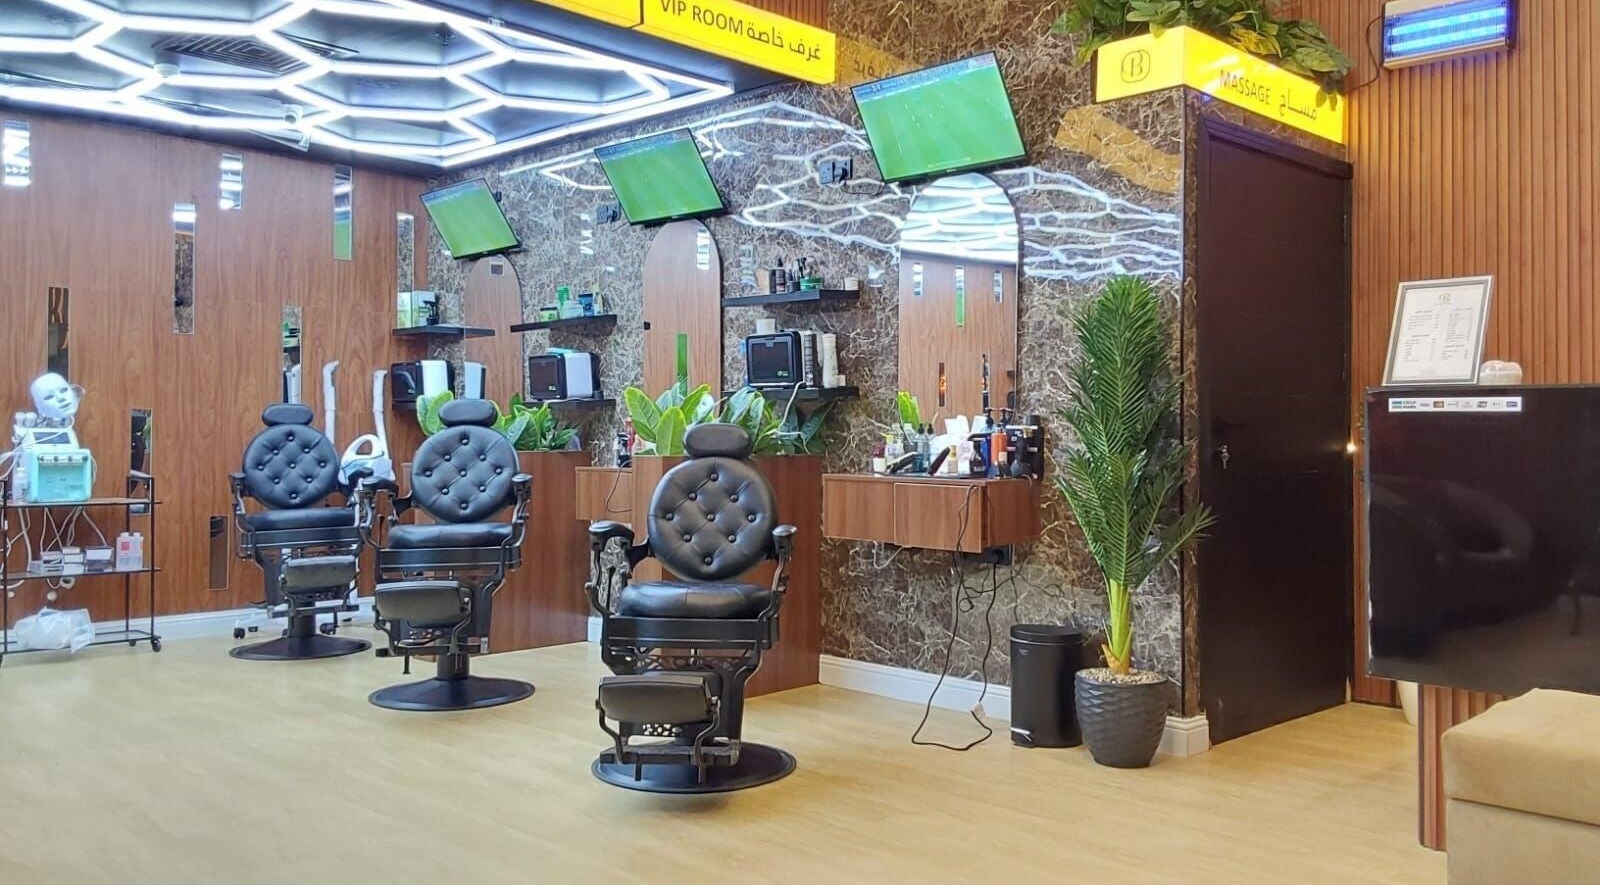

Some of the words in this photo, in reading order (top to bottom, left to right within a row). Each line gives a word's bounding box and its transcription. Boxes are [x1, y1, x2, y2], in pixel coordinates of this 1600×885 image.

[661, 0, 687, 16] VIP
[692, 5, 743, 36] ROOM
[746, 22, 784, 48] خاصة
[789, 38, 821, 61] غرف
[1219, 70, 1272, 105] MASSAGE
